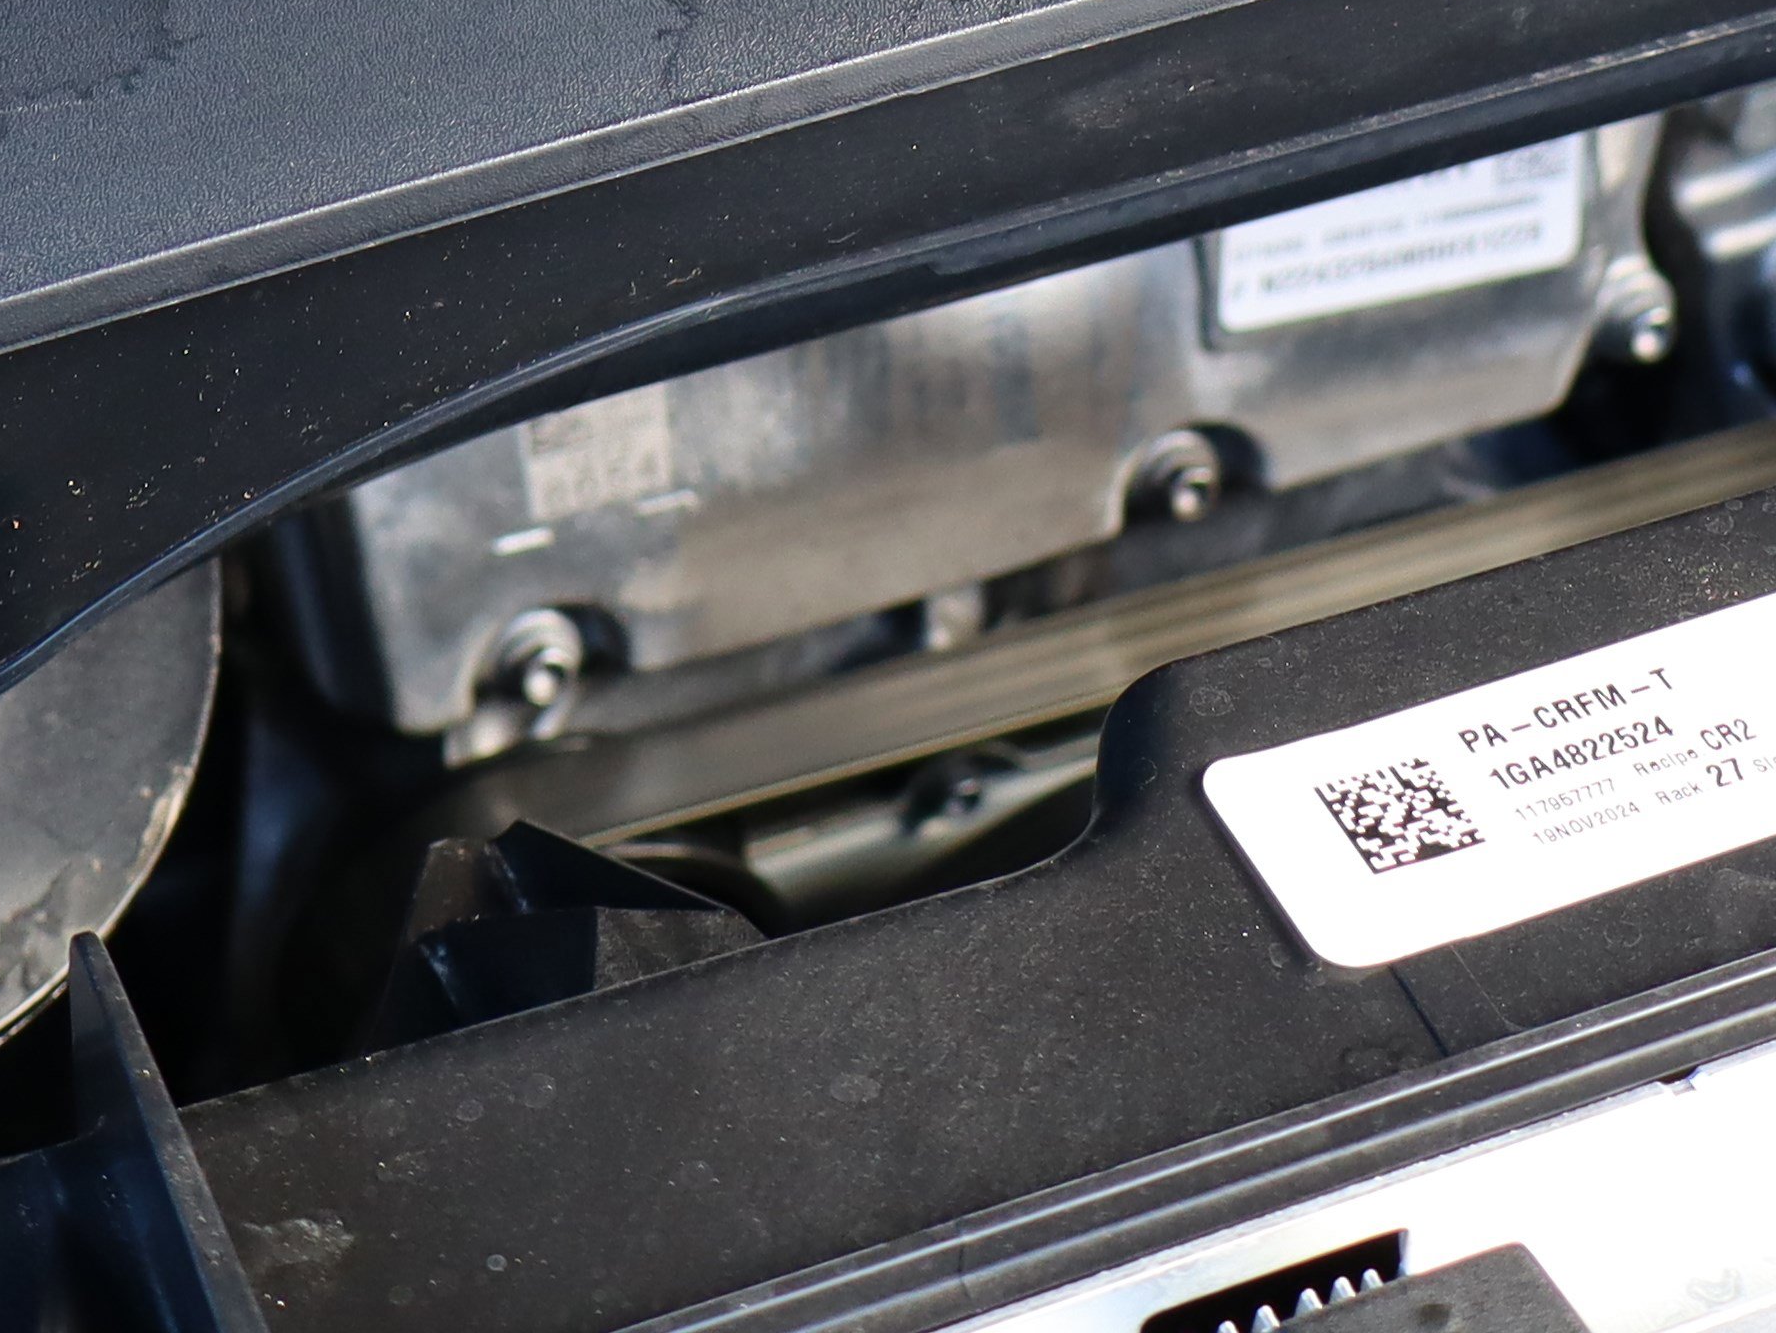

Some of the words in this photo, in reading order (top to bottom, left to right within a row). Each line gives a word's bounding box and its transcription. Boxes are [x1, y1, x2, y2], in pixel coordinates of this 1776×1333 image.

[1488, 715, 1675, 790] 1GA4822524
[1699, 717, 1758, 751] CR2
[1532, 800, 1642, 846] 19NOV2024
[1654, 781, 1704, 806] Rack
[1705, 756, 1745, 788] 27
